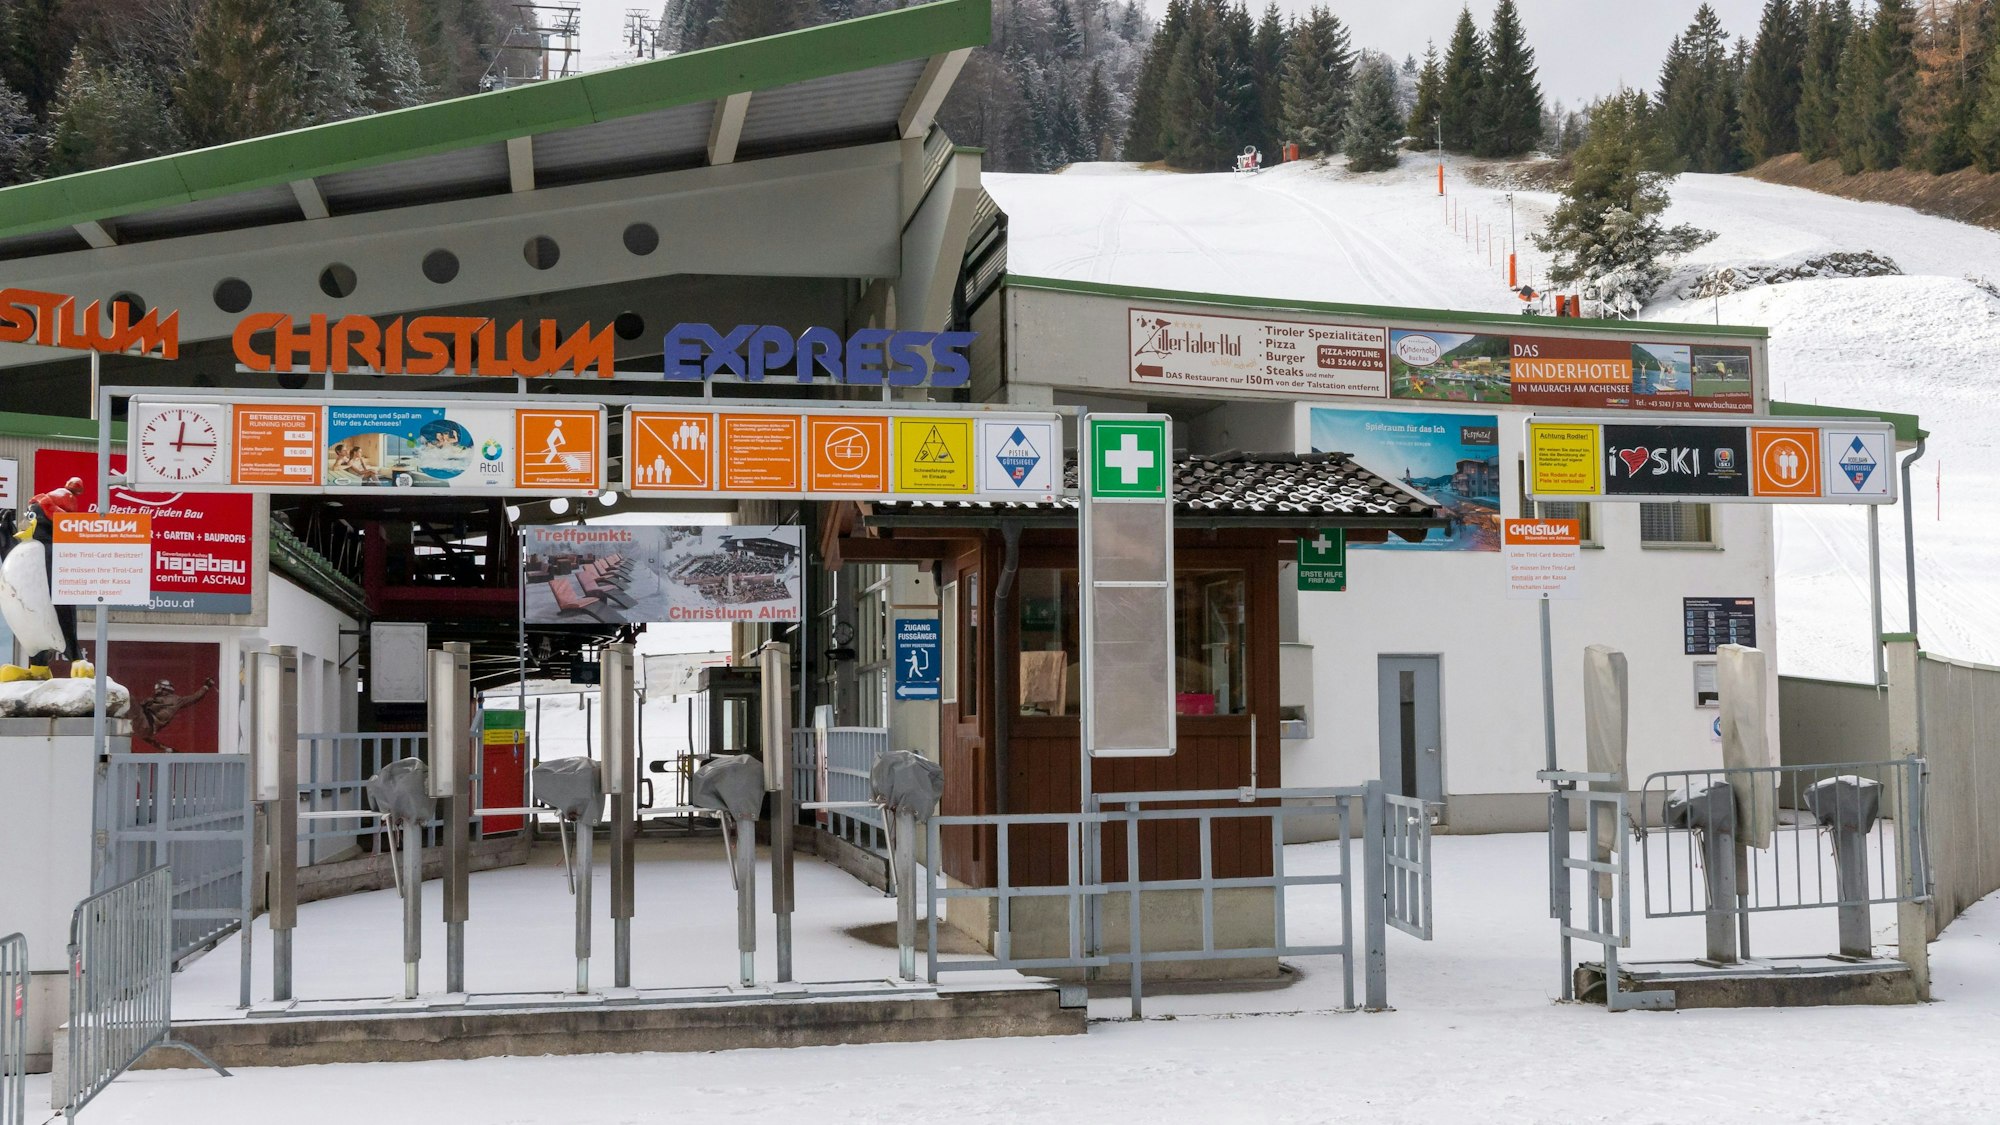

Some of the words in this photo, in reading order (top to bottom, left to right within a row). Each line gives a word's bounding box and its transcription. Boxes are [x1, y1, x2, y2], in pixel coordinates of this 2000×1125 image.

[1265, 325, 1305, 338] Tiroler
[1308, 328, 1383, 343] Spezialitäten
[232, 312, 615, 379] CHRISTLUM
[663, 323, 981, 388] EXPRESS
[1265, 338, 1296, 350] Pizza
[1400, 342, 1437, 357] Kinderhotel
[1320, 347, 1381, 359] PIZZA-HOTLINE:
[1513, 344, 1539, 357] DAS
[1265, 351, 1306, 365] Burger
[1320, 358, 1336, 366] +43
[1373, 360, 1384, 368] 96
[1266, 365, 1304, 377] Steaks
[1515, 362, 1630, 379] KINDERHOTEL
[1165, 371, 1183, 379] DAS
[1185, 373, 1228, 383] Restaurant
[1230, 376, 1244, 384] nur
[1291, 380, 1305, 388] der
[1306, 381, 1346, 390] Talstation
[1347, 383, 1380, 392] entfernt
[1517, 384, 1528, 393] IN
[1529, 384, 1571, 393] MAURACH
[1573, 384, 1587, 393] AM
[1588, 384, 1630, 393] ACHENSEE
[1693, 400, 1753, 410] www.buchau.com
[332, 412, 377, 420] Entspannung
[1365, 422, 1405, 433] Spielraum
[1406, 424, 1418, 433] für
[1419, 424, 1432, 433] das
[1433, 424, 1446, 434] Ich
[1008, 449, 1029, 457] PISTEN
[480, 462, 504, 473] Atoll
[1002, 458, 1034, 466] GÜTESIEGEL
[1650, 447, 1700, 478] SKI
[1844, 463, 1872, 472] GÜTESIEGEL
[109, 504, 137, 514] Beste
[139, 505, 154, 515] für
[153, 507, 182, 519] jeden
[183, 508, 204, 519] Bau
[59, 519, 137, 533] CHRISTLUM
[1509, 524, 1569, 536] CHRISTLUM
[163, 531, 195, 541] GARTEN
[204, 532, 246, 544] BAUPROFIS
[534, 528, 632, 545] Treffpunkt:
[156, 551, 246, 575] hagebau
[156, 574, 198, 583] centrum
[202, 574, 246, 586] ASCHAU
[1300, 570, 1322, 578] ERSTE
[59, 578, 88, 586] einmalig
[669, 606, 753, 619] Christlum
[758, 606, 797, 619] Alm!
[904, 624, 931, 632] ZUGANG
[898, 632, 937, 640] FUSSGÄNGER
